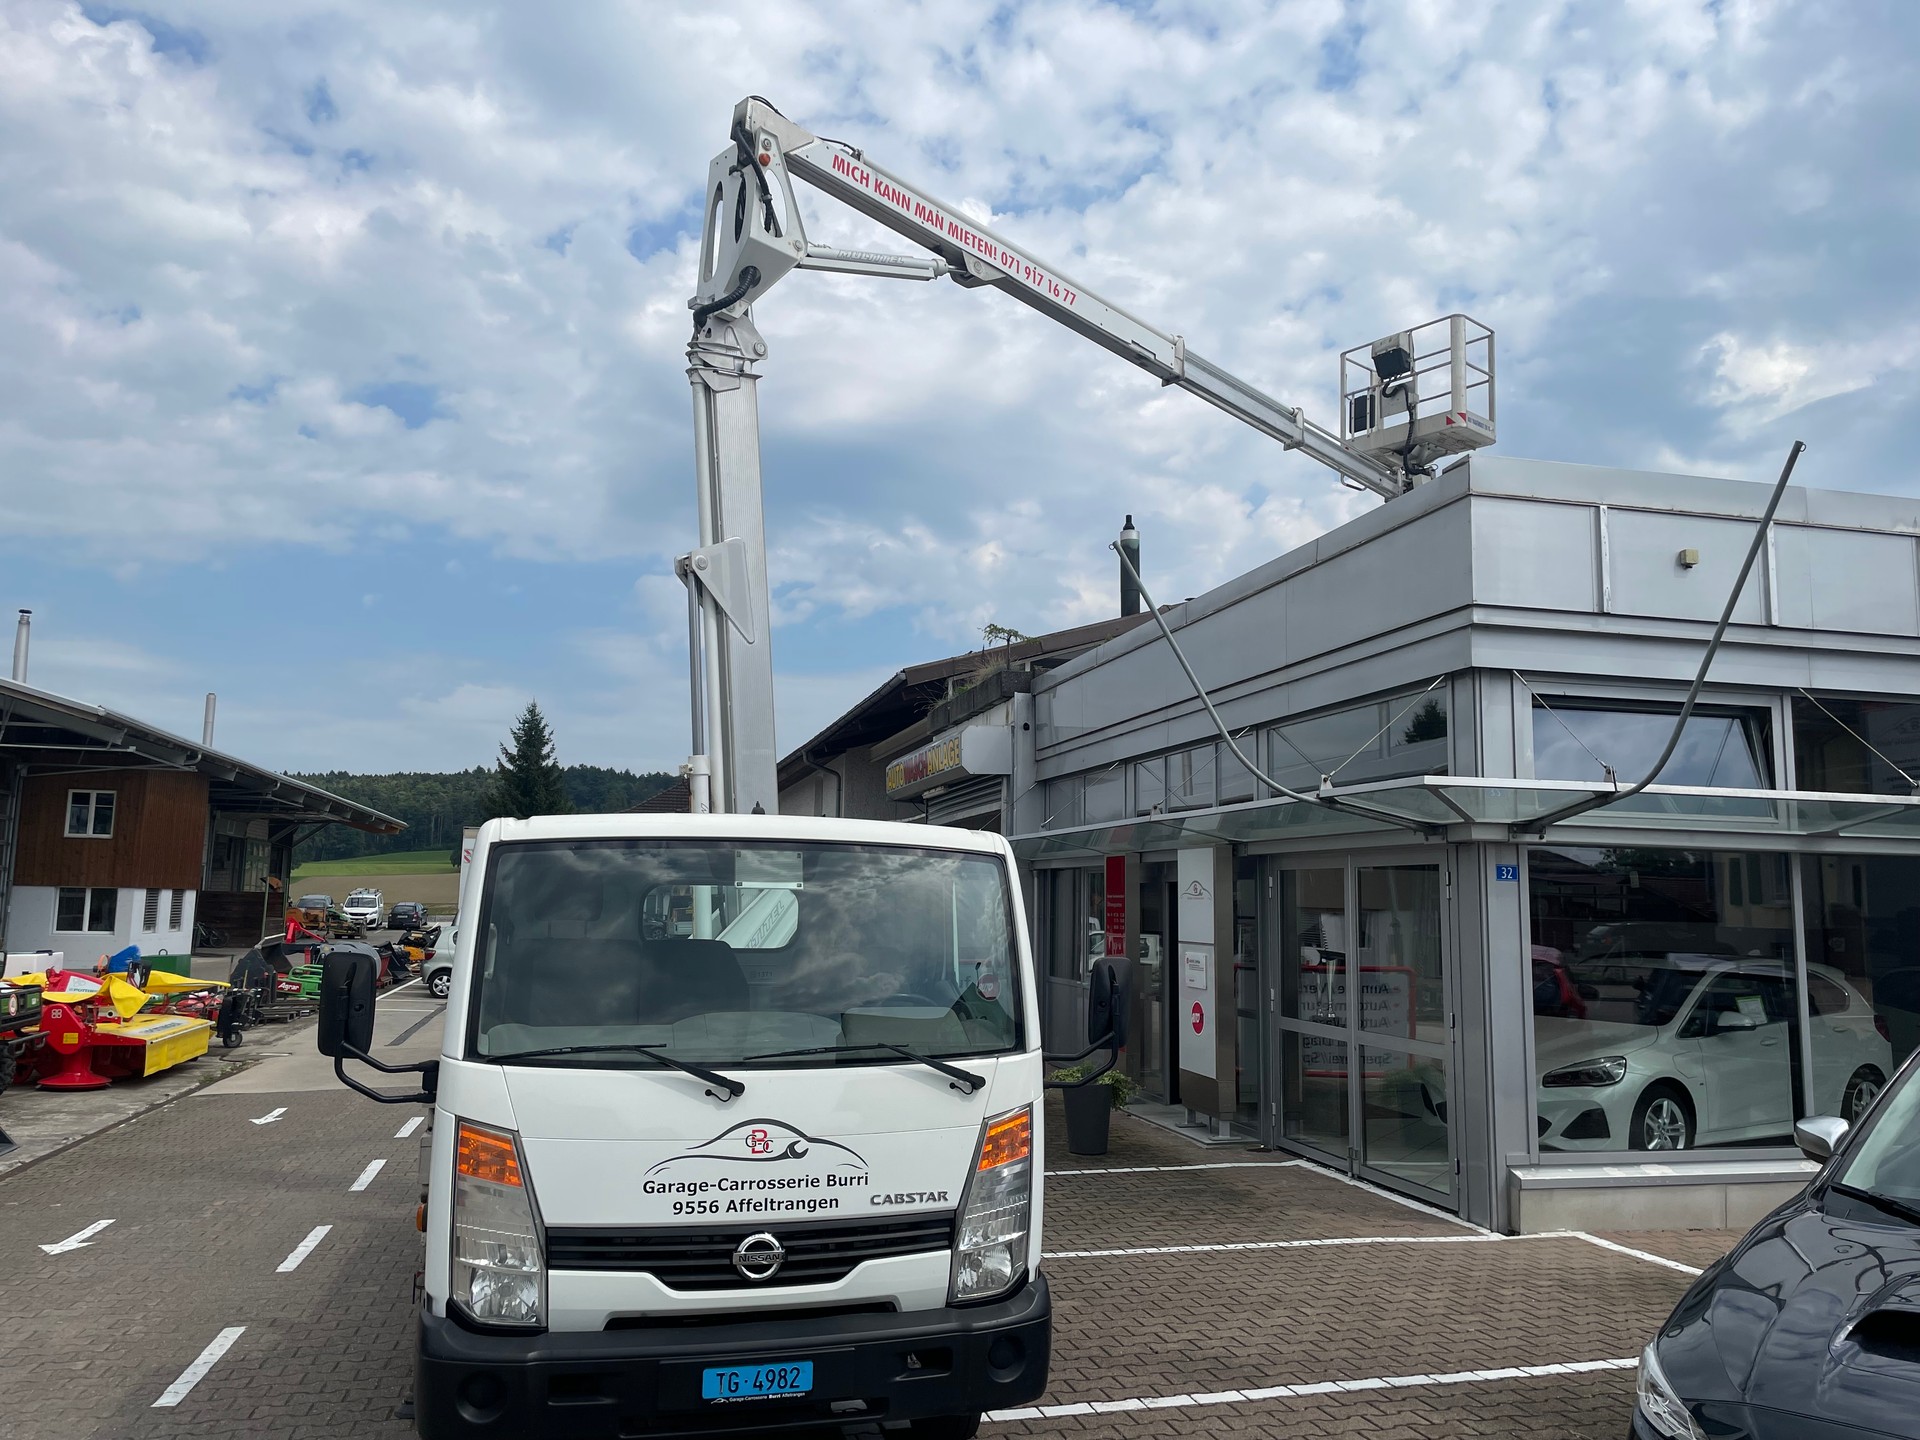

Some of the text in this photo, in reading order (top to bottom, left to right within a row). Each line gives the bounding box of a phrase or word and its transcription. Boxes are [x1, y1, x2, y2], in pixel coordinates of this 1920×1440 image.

[832, 154, 1077, 306] MICH KANN MAN MIETEN! 071 917 16 77
[1501, 867, 1513, 879] 32
[277, 982, 300, 991] Agrar
[643, 1172, 869, 1196] Garage-Carrosserie Burri
[672, 1196, 839, 1215] 9556 Affeltrangen
[870, 1191, 949, 1206] CABSTAR
[739, 1253, 780, 1263] NISSAN
